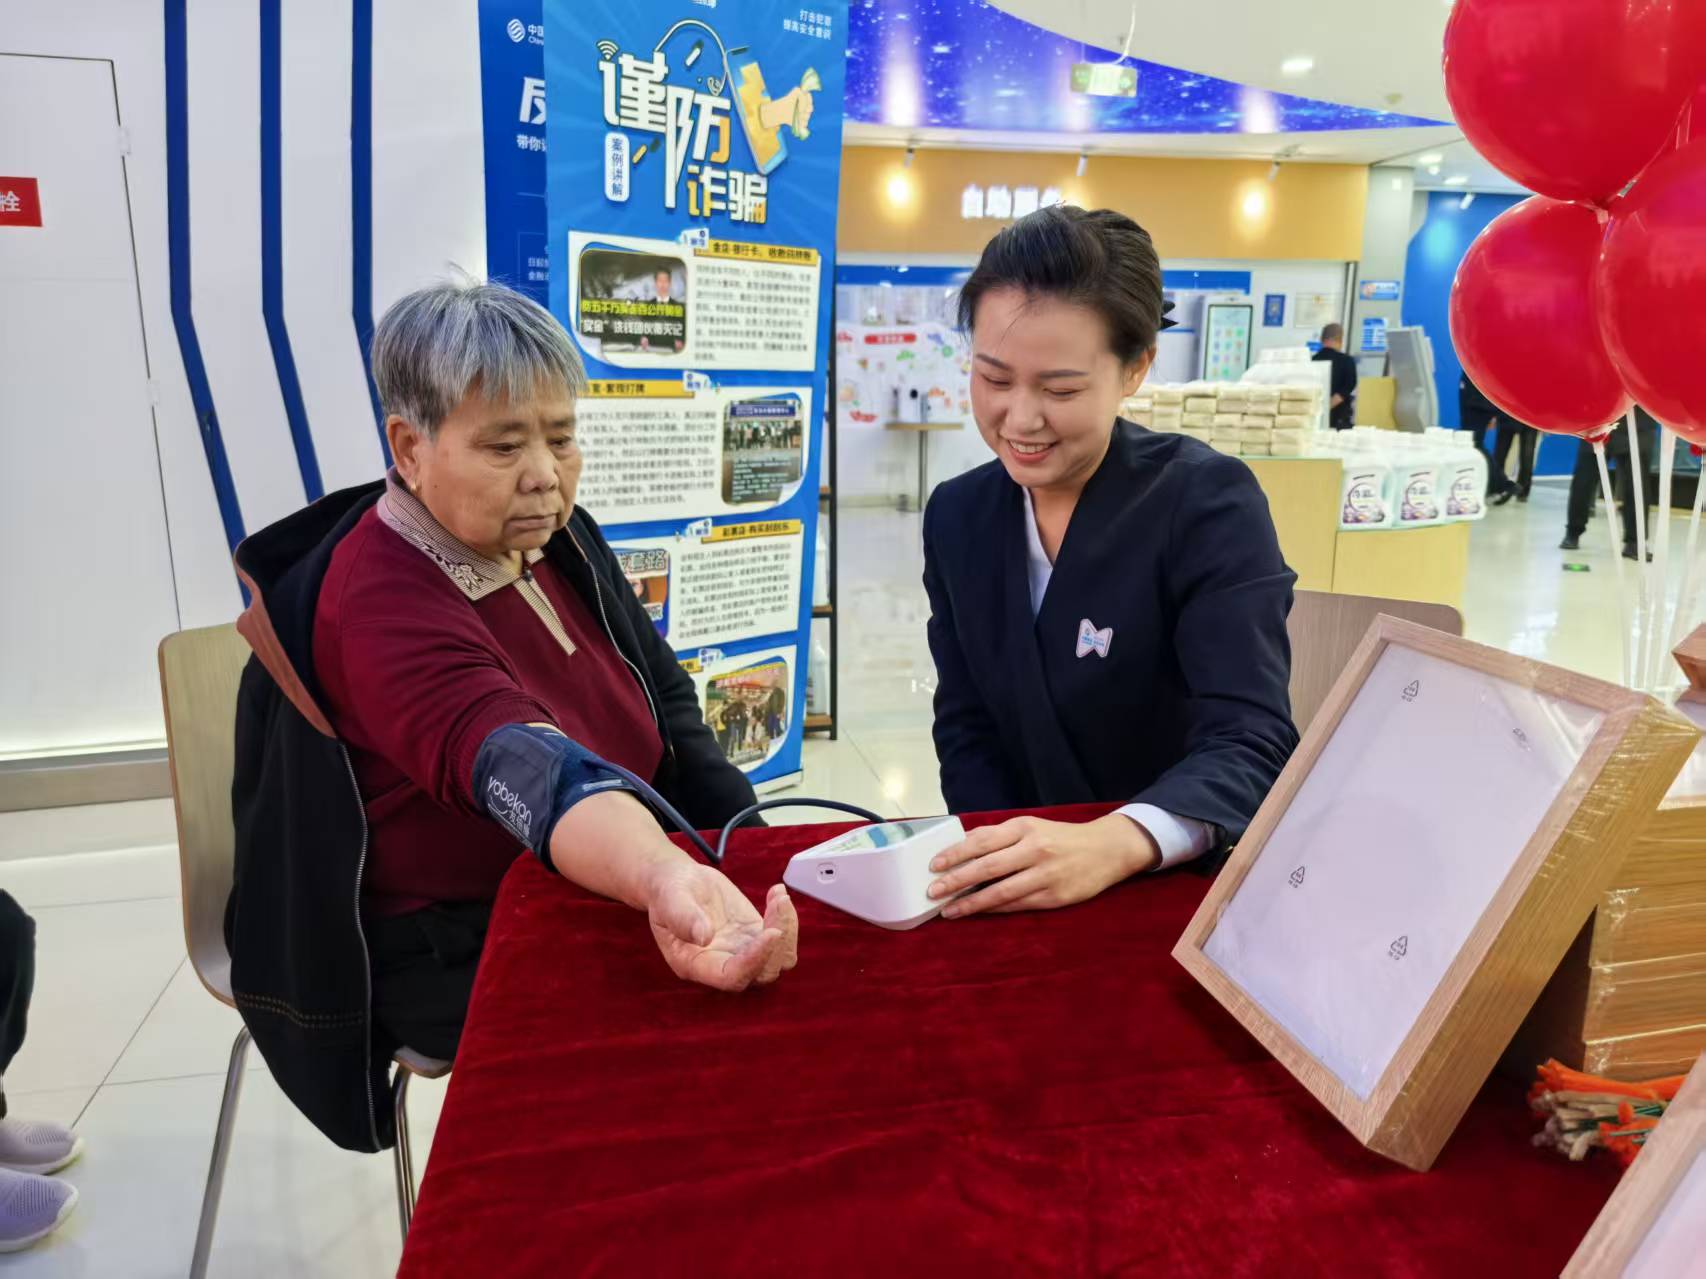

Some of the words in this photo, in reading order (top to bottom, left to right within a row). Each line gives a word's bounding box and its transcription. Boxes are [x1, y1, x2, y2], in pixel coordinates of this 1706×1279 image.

[599, 51, 731, 210] 谨防
[610, 137, 624, 197] 案例讲解
[687, 165, 768, 225] 诈骗
[0, 190, 21, 212] 栓
